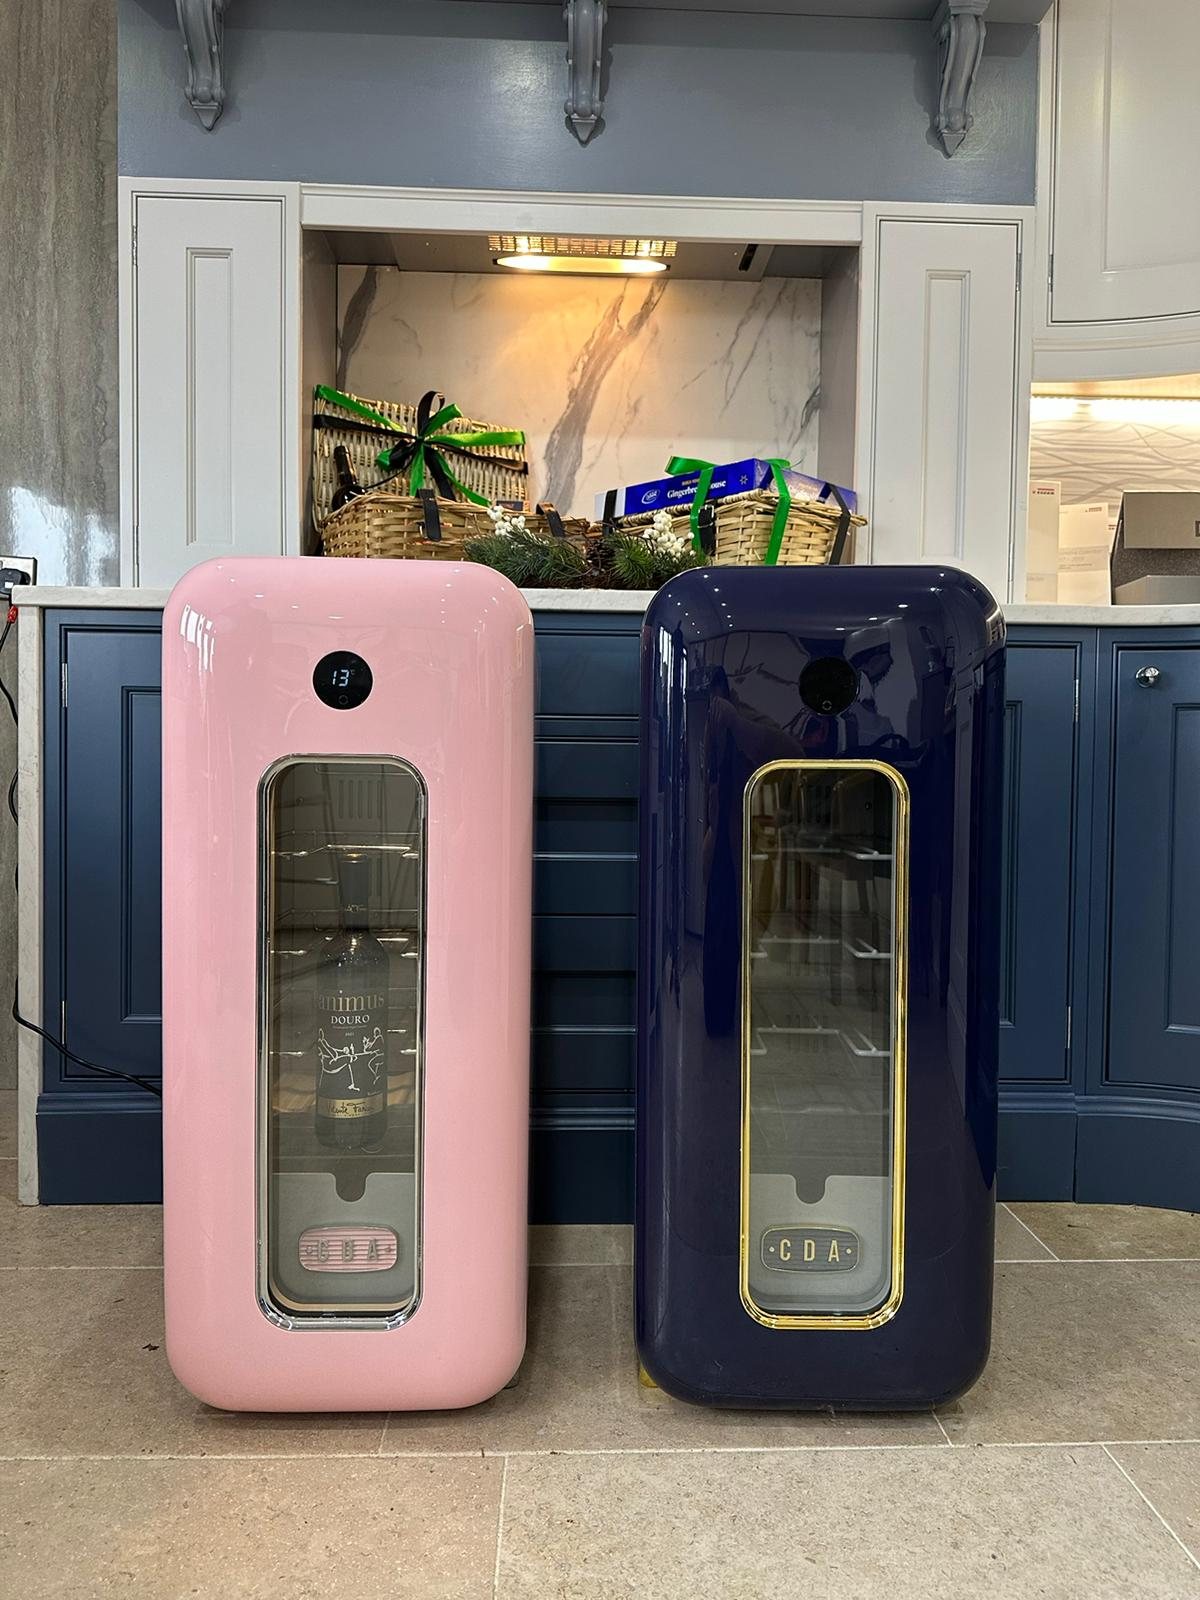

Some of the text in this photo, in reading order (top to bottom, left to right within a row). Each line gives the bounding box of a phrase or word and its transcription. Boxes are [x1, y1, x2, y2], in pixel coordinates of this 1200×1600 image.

[667, 486, 698, 499] Gingerbre
[332, 669, 350, 687] 13
[331, 1014, 370, 1025] DOURO
[780, 1238, 840, 1262] CDA
